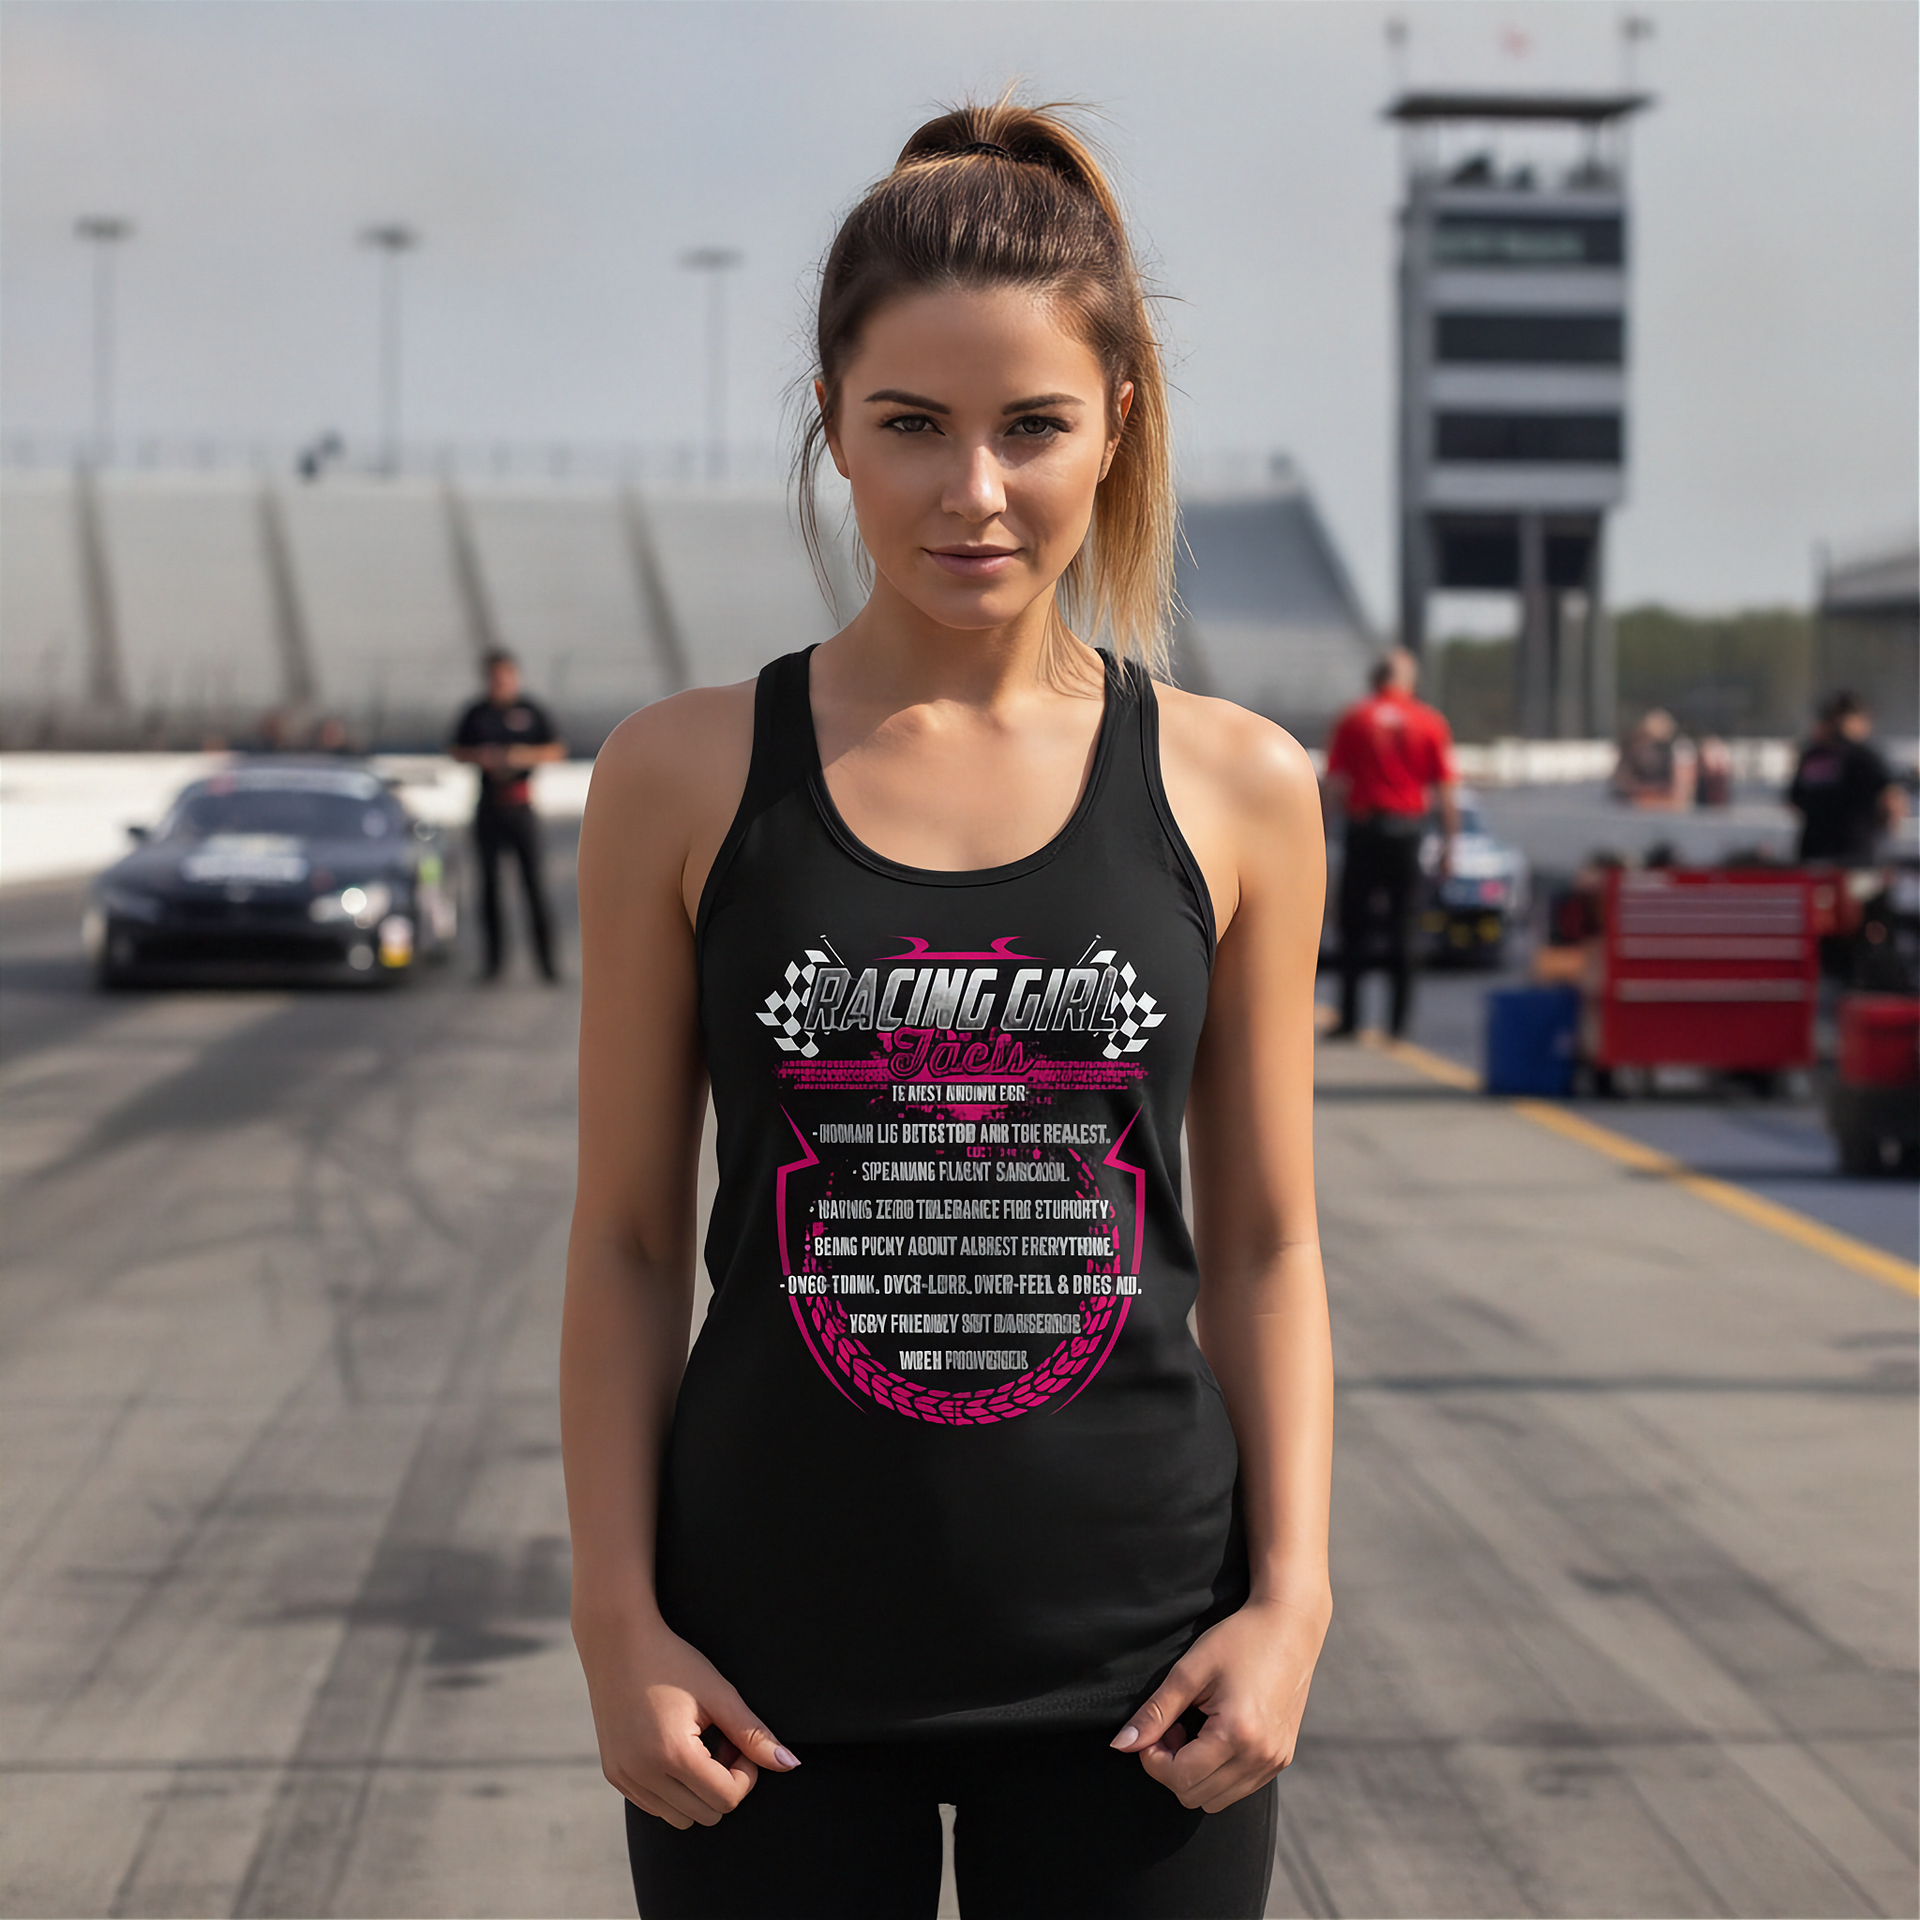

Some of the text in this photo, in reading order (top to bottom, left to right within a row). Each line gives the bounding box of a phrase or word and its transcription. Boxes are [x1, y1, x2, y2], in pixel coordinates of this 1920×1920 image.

[804, 967, 1117, 1032] RACING GIRL
[1057, 1275, 1069, 1295] &
